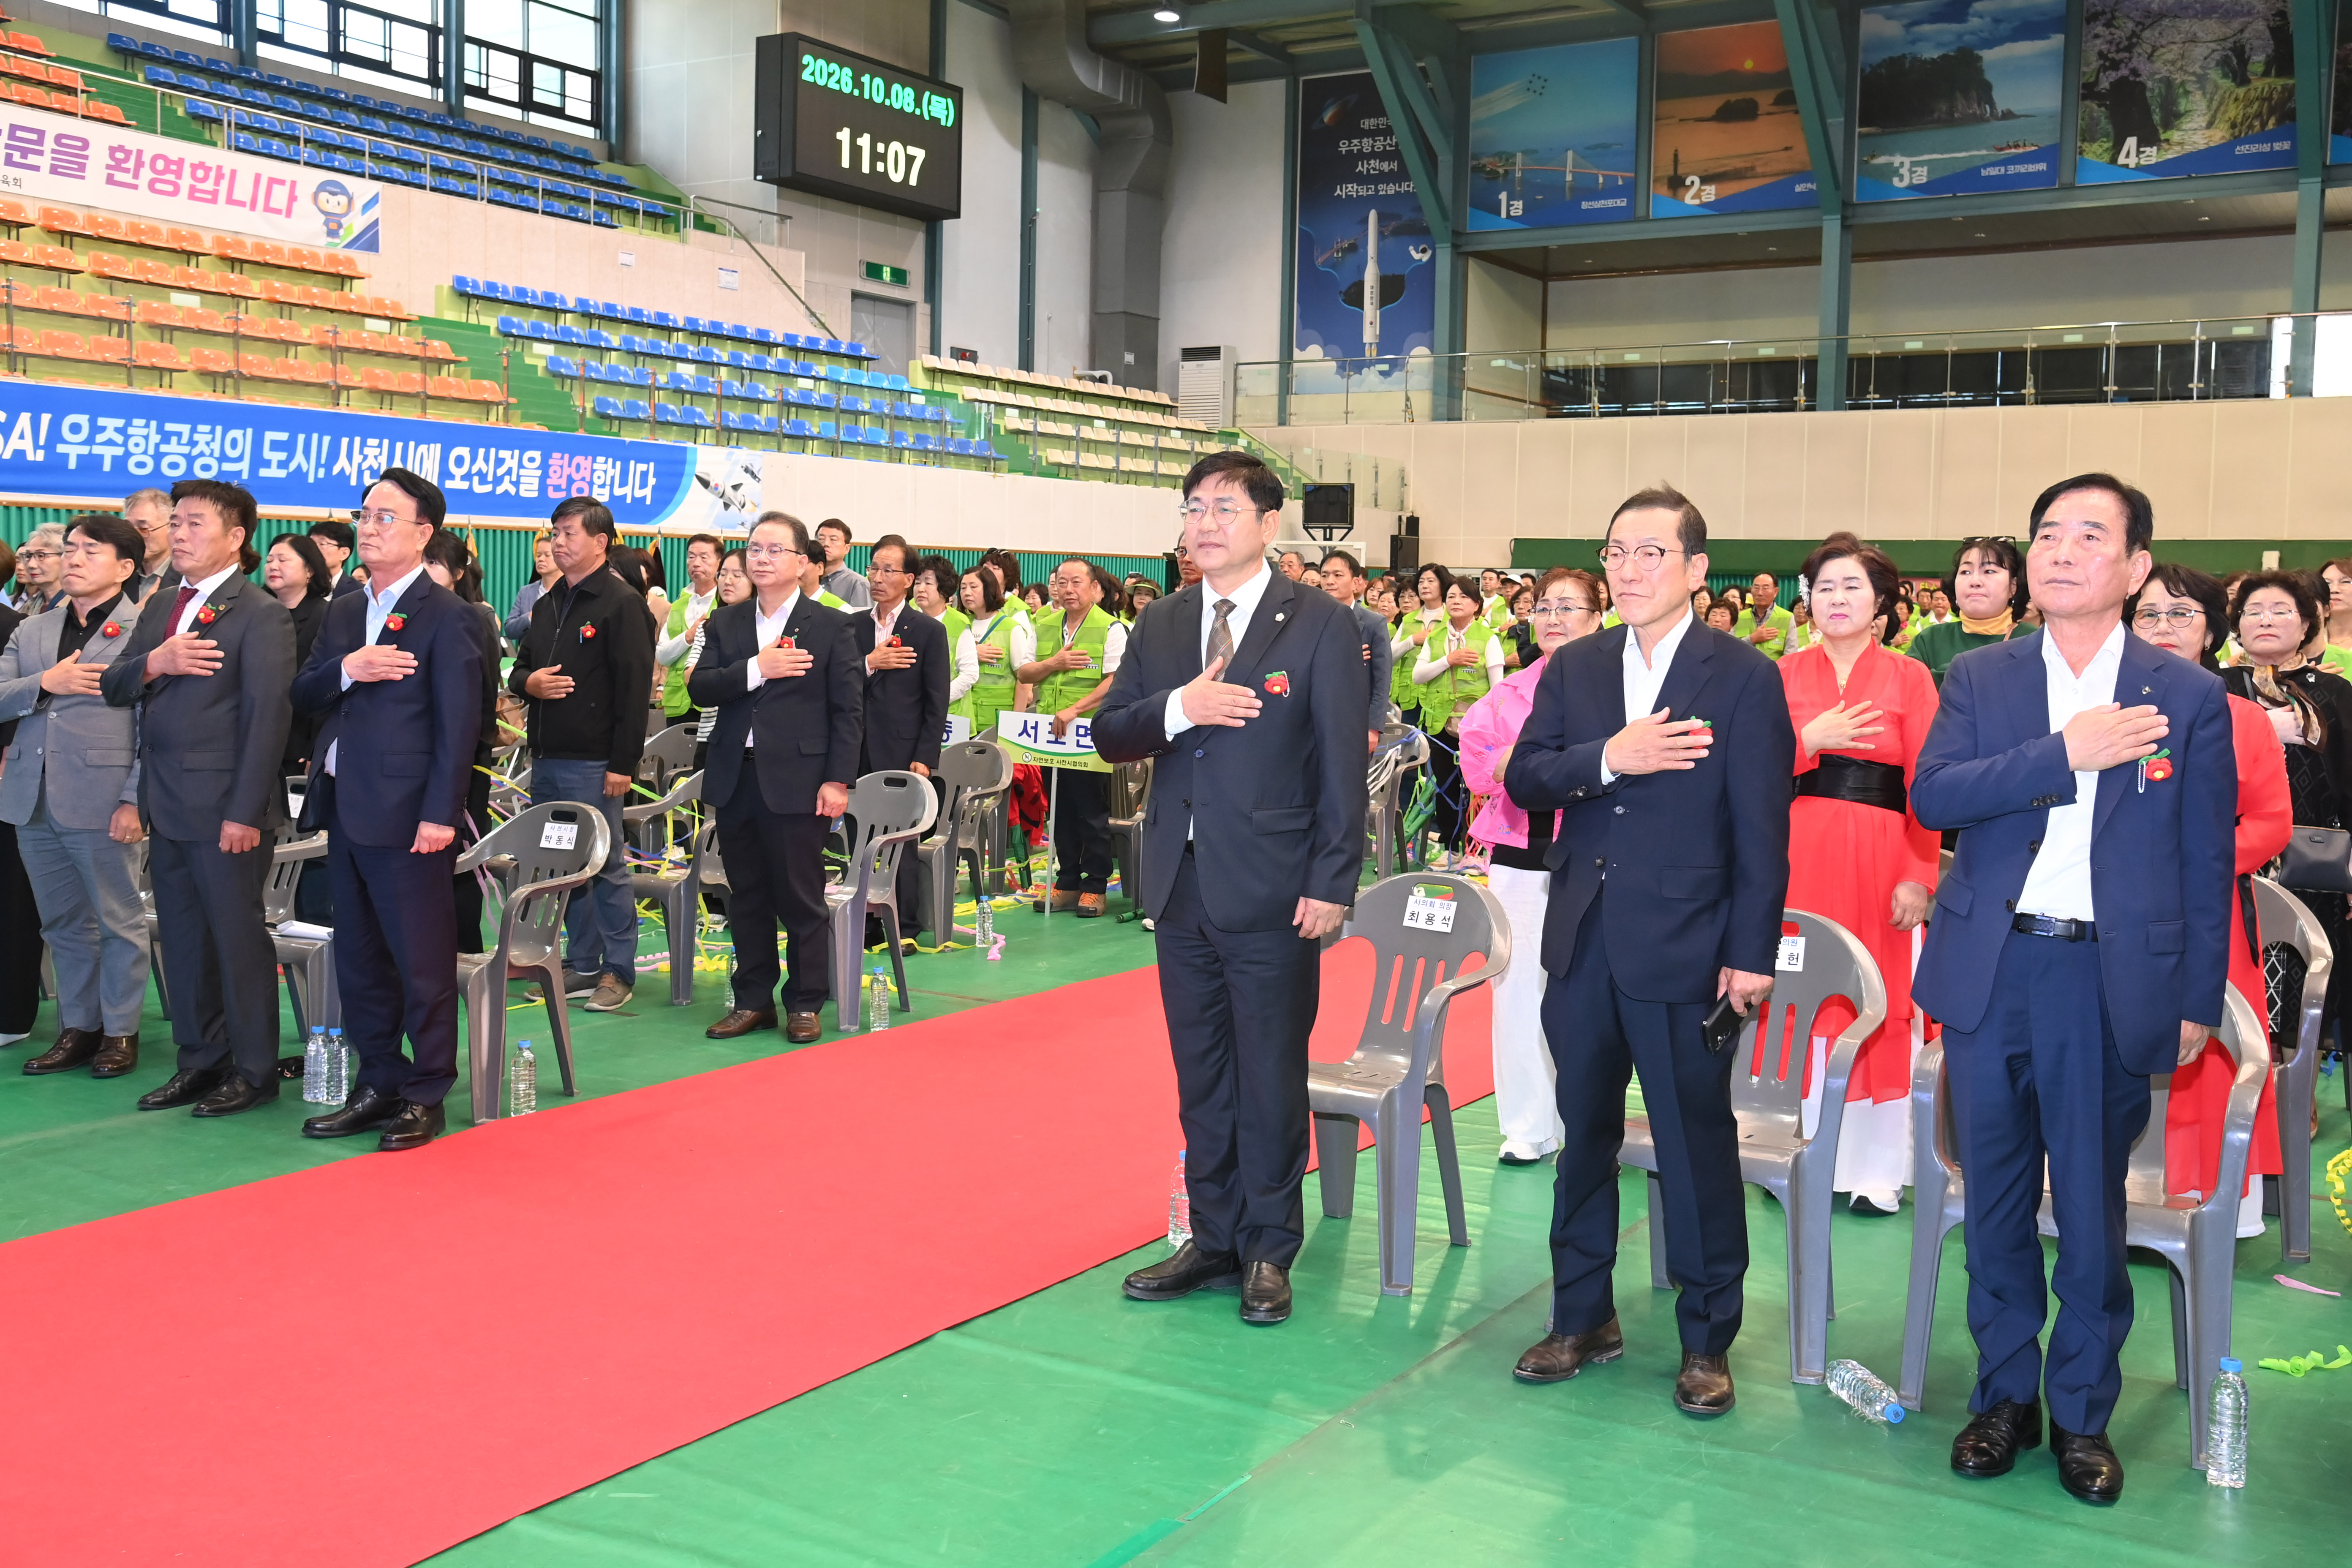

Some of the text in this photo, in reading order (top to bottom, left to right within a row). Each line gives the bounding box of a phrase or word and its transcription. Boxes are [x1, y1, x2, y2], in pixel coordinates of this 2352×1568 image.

[801, 54, 955, 127] 2026.10.08.(목)
[836, 127, 926, 186] 11:07
[1338, 135, 1400, 155] 우주항공산
[2117, 136, 2159, 168] 4경
[0, 123, 298, 218] 문을 환영합니다
[1355, 159, 1397, 175] 사천에서
[1892, 156, 1928, 188] 3경
[1334, 181, 1416, 199] 시작되고 있습니다.
[1684, 175, 1716, 205] 2경
[1498, 191, 1523, 219] 1경
[56, 414, 253, 479] 우주항공청의
[259, 430, 331, 483] 도시!
[332, 436, 442, 486] 사천시에
[444, 446, 542, 498] 오신것을
[546, 452, 656, 505] 환영합니다
[1056, 759, 1088, 768] 사천시협의회
[1414, 898, 1452, 910] 시의회 의장
[1782, 939, 1797, 947] 의원
